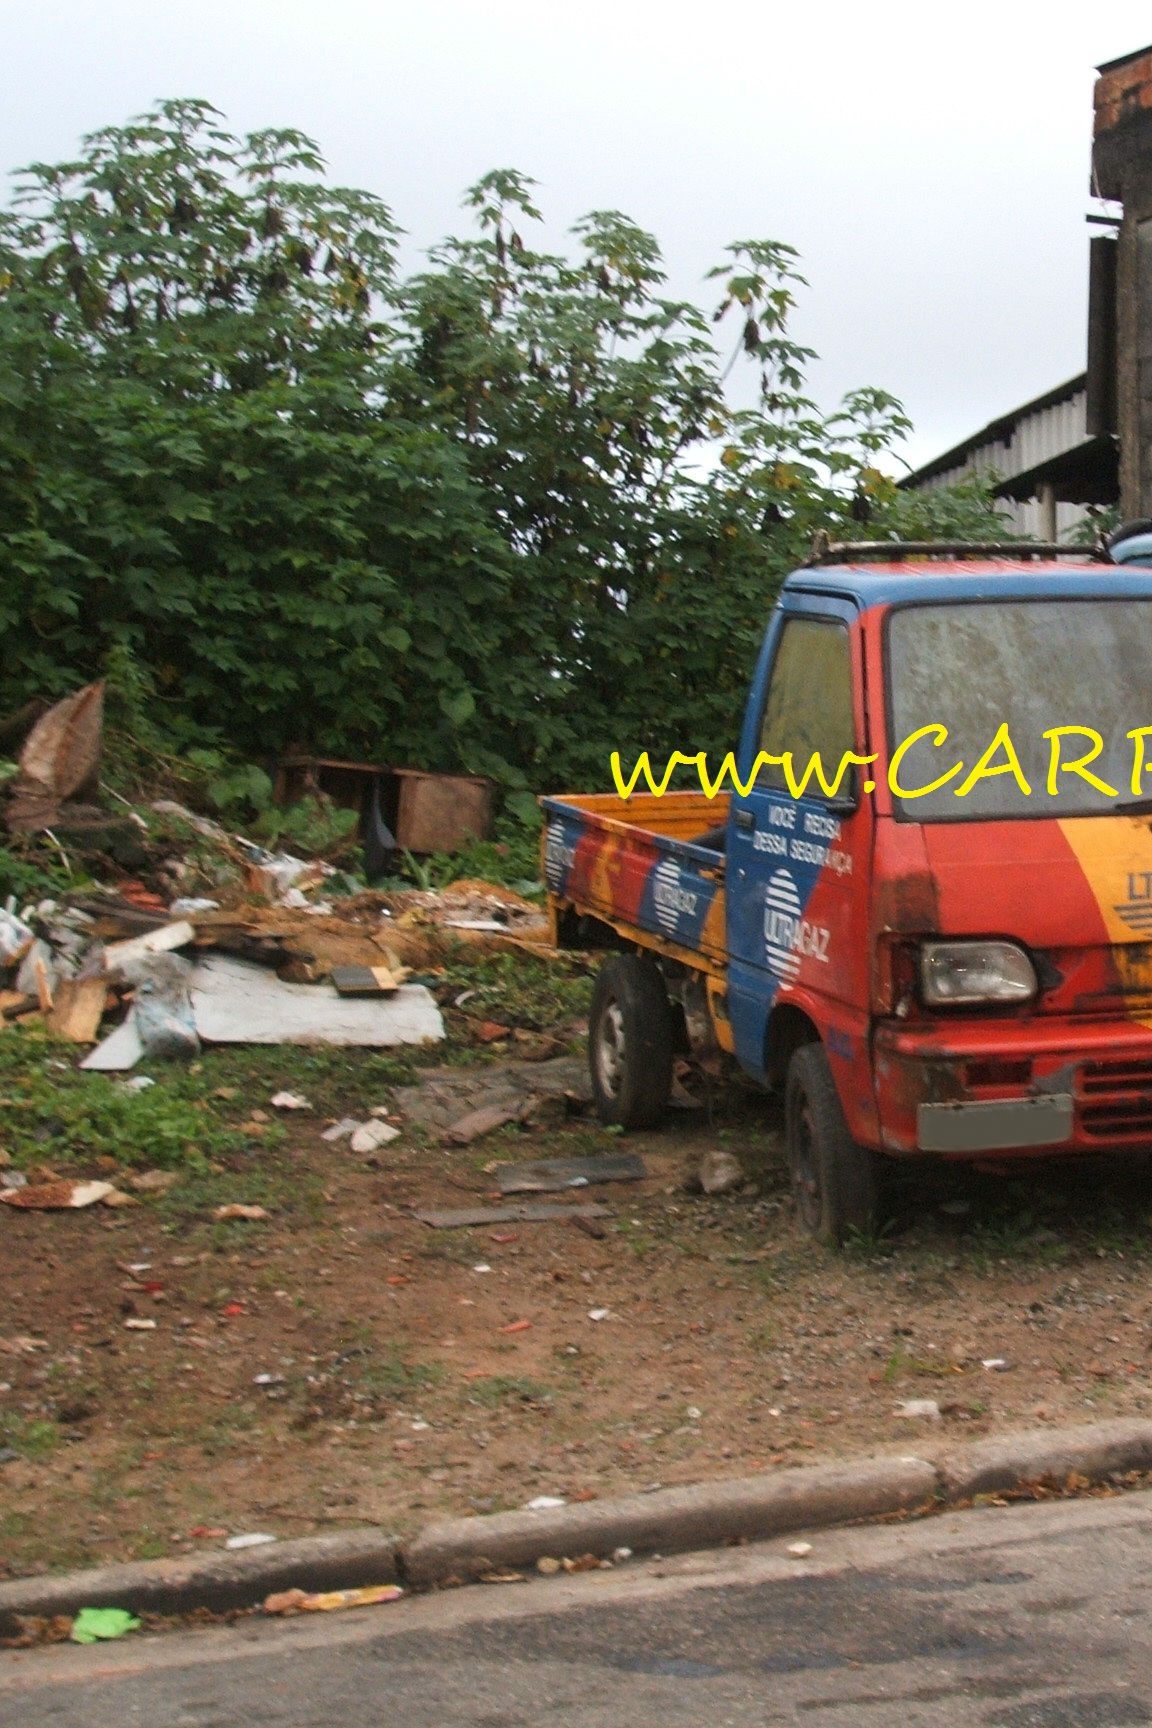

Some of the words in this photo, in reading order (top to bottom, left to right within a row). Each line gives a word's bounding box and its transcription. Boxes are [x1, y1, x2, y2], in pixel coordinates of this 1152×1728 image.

[753, 830, 788, 857] DESSA
[789, 838, 853, 876] SEGURANÇA
[764, 908, 831, 963] ULTRAGAZ
